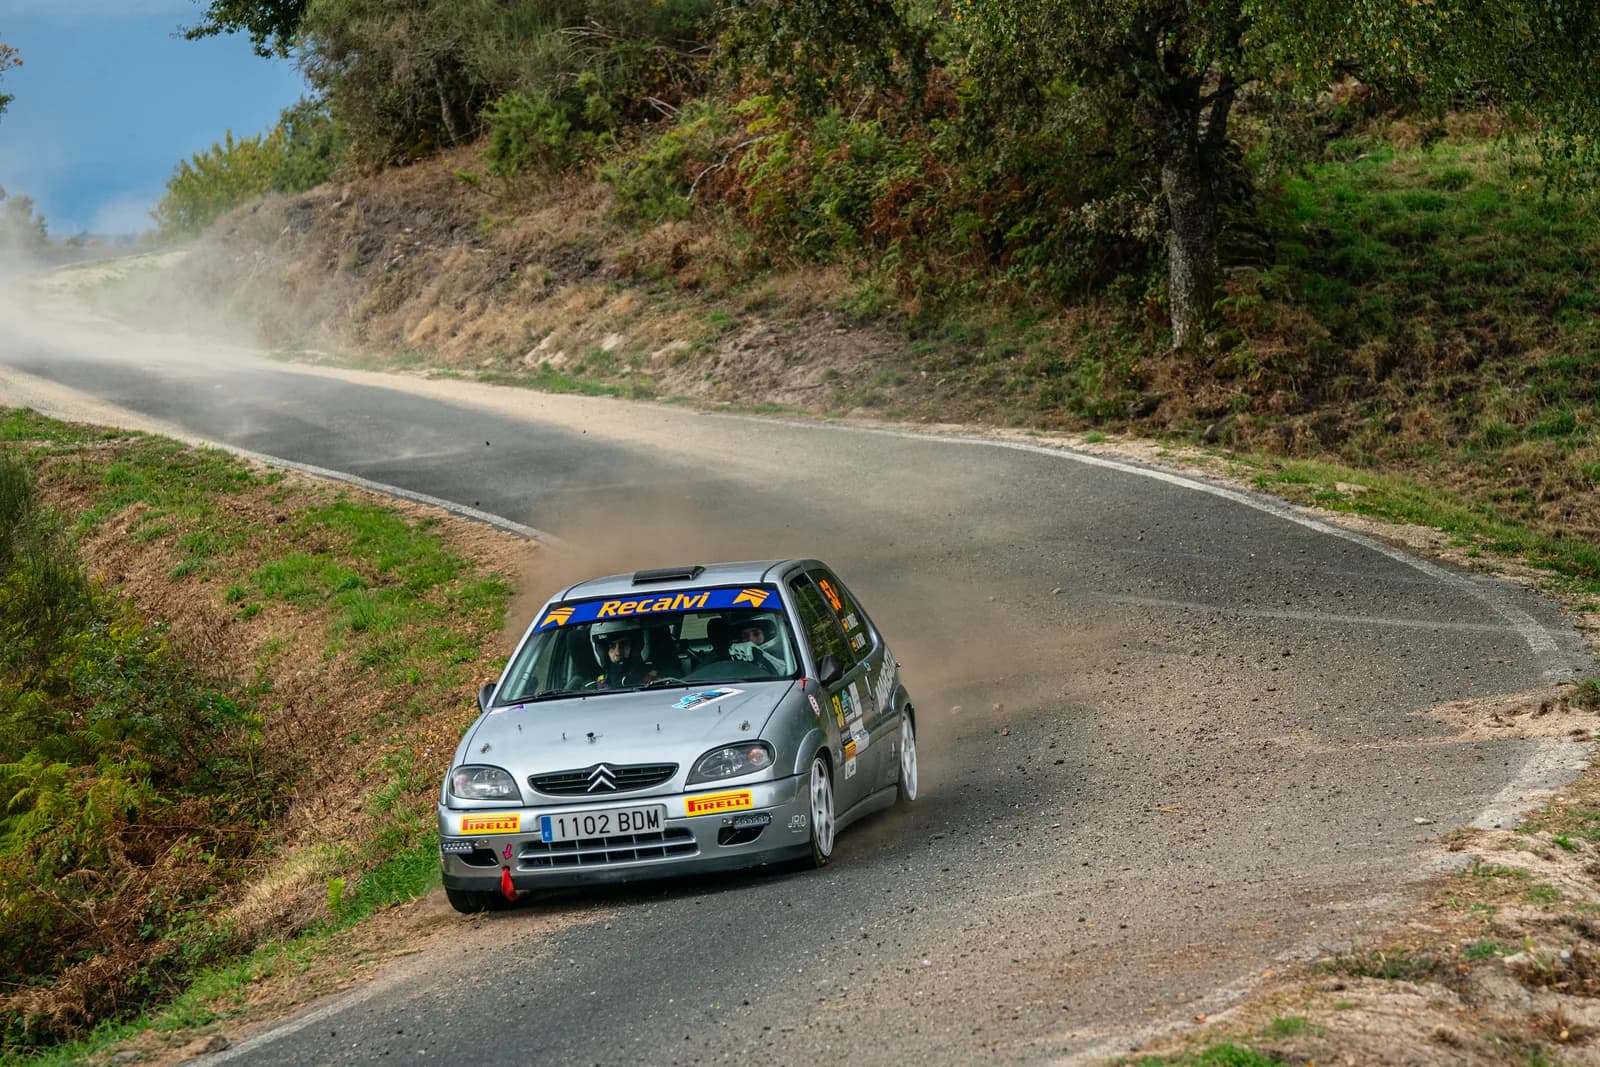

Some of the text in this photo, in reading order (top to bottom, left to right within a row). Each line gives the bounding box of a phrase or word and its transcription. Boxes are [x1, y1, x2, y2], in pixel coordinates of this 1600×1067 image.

[596, 591, 711, 618] Recalvi
[687, 793, 750, 813] PIRELLI
[462, 816, 518, 831] PIRELLI
[558, 809, 660, 838] 1102 BDM
